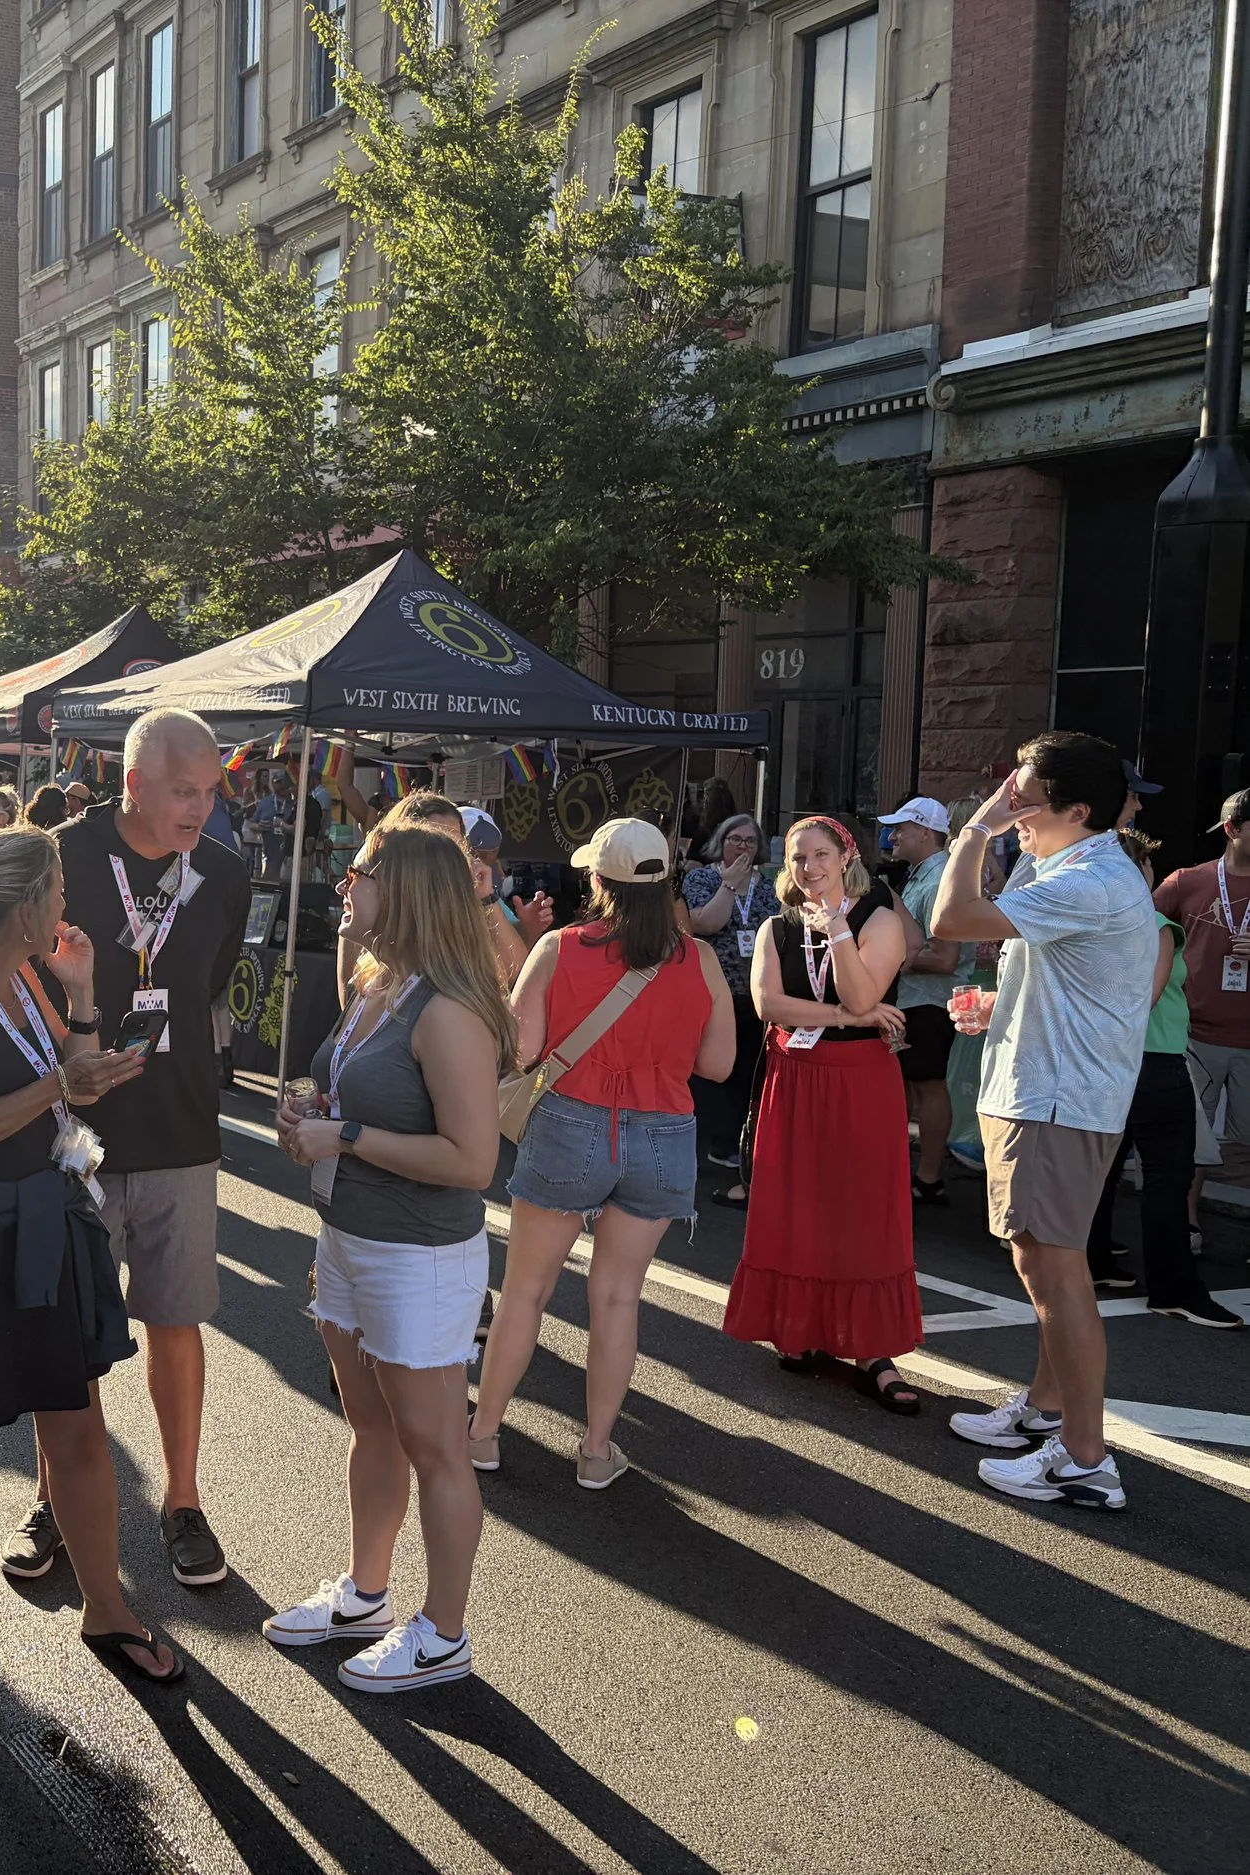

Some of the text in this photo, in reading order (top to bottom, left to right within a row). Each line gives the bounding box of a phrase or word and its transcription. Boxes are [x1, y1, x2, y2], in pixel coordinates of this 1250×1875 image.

[399, 595, 416, 620] WEST
[410, 589, 450, 604] SIXTH
[760, 648, 805, 679] 819
[343, 688, 521, 716] WEST SIXTH BREWING
[592, 704, 677, 728] KENTUCKY
[136, 896, 167, 909] LOU
